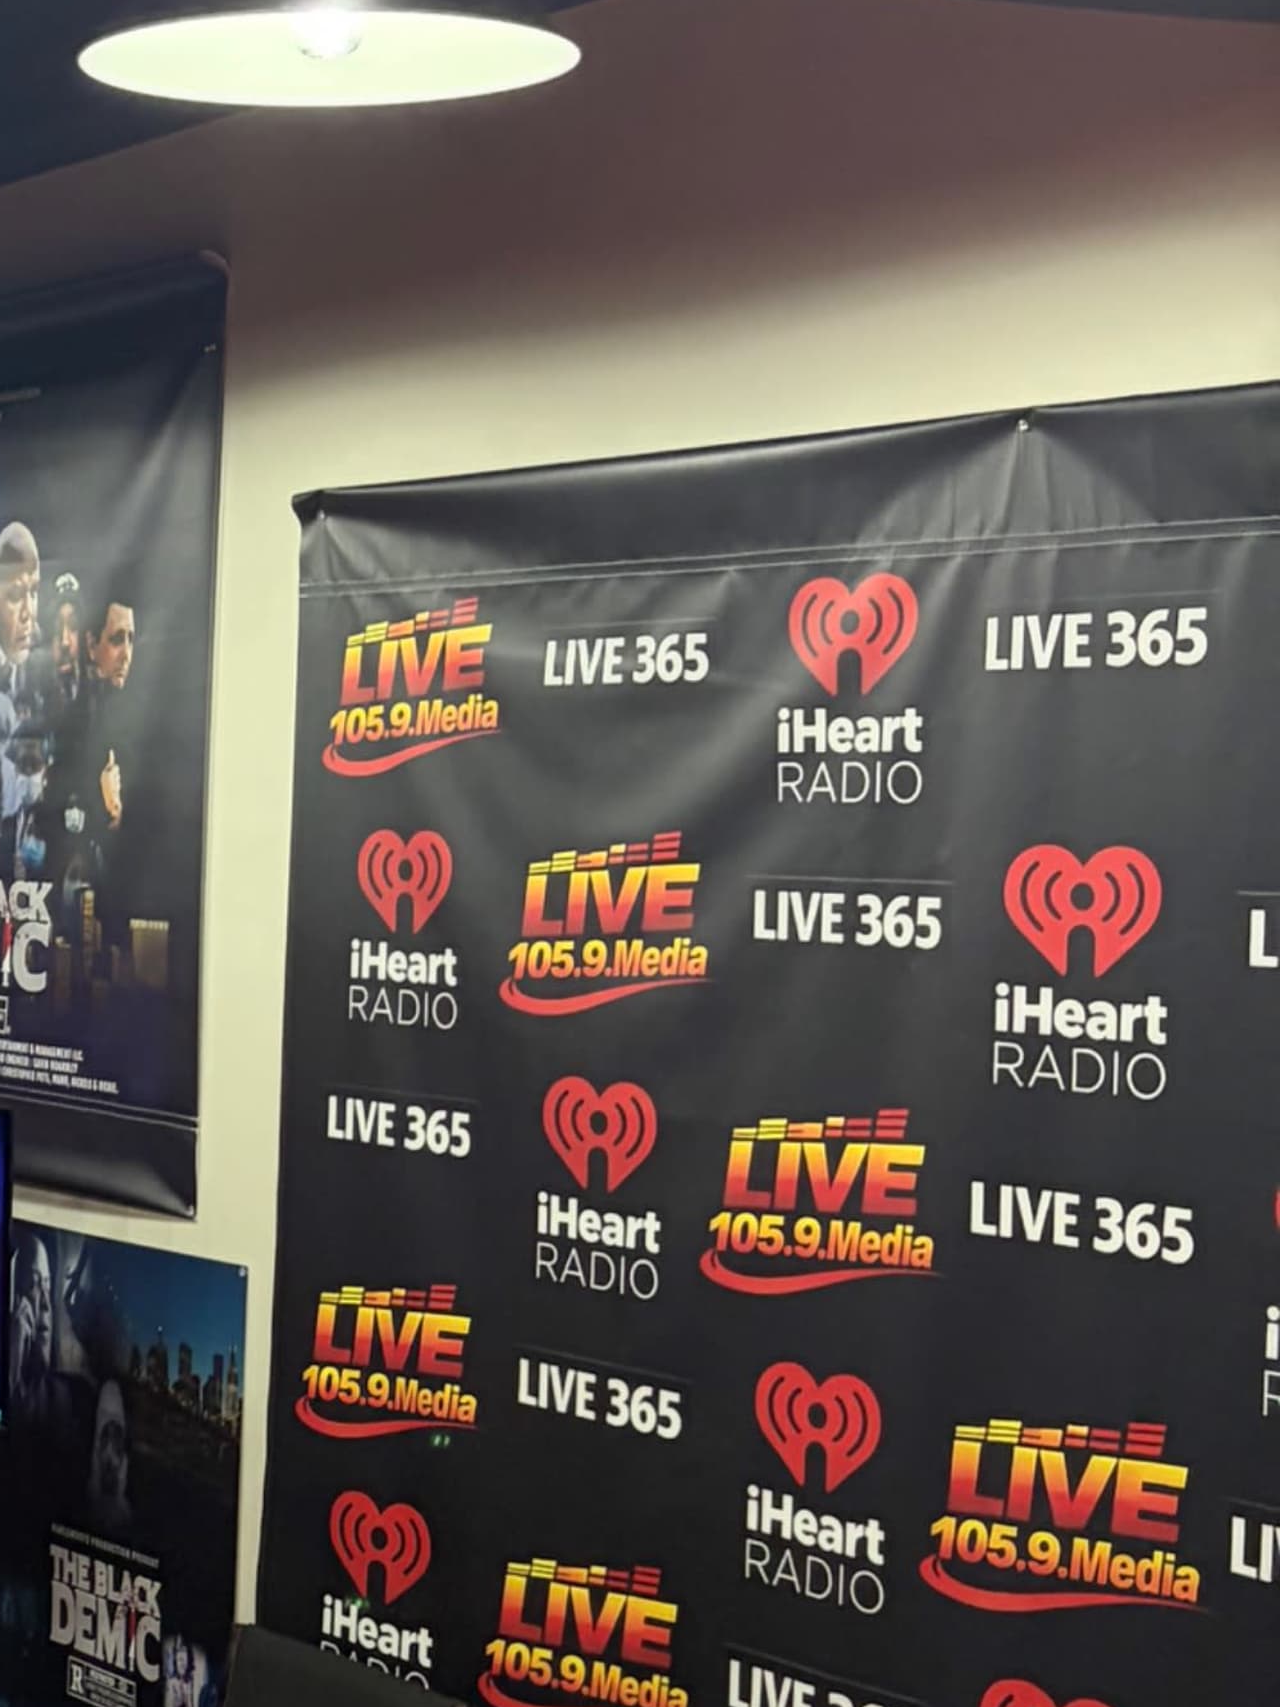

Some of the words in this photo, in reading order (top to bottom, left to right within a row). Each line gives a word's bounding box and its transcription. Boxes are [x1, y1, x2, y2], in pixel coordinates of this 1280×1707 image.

[340, 623, 493, 705] LIVE
[543, 638, 624, 686] LIVE
[632, 633, 710, 685] 365
[985, 612, 1092, 671] LIVE
[1106, 607, 1208, 668] 365
[329, 694, 499, 744] 105.9.Media
[777, 708, 923, 753] iHeart
[777, 760, 923, 805] RADIO
[521, 863, 701, 937] LIVE
[753, 890, 845, 944] LIVE
[855, 894, 942, 950] 365
[350, 939, 458, 986] iHeart
[508, 937, 709, 981] 105.9.Media
[348, 986, 458, 1030] RADIO
[994, 982, 1168, 1045] iHeart
[992, 1041, 1167, 1100] RADIO
[327, 1094, 395, 1148] LIVE
[404, 1105, 471, 1158] 365
[722, 1139, 926, 1216] LIVE
[537, 1190, 661, 1254] iHeart
[708, 1211, 935, 1270] 105.9.Media
[969, 1180, 1081, 1249] LIVE
[1092, 1196, 1196, 1265] 365
[535, 1242, 660, 1299] RADIO
[312, 1302, 471, 1378] LIVE
[301, 1364, 478, 1425] 105.9.Media
[517, 1357, 596, 1421] LIVE
[605, 1378, 683, 1439] 365
[946, 1439, 1189, 1543] LIVE
[746, 1484, 886, 1567] iHeart
[50, 1544, 90, 1588] THE
[94, 1559, 162, 1618] BLACK
[744, 1539, 885, 1615] RADIO
[930, 1515, 1201, 1604] 105.9.Media
[321, 1593, 433, 1669] iHeart
[498, 1570, 679, 1669] LIVE
